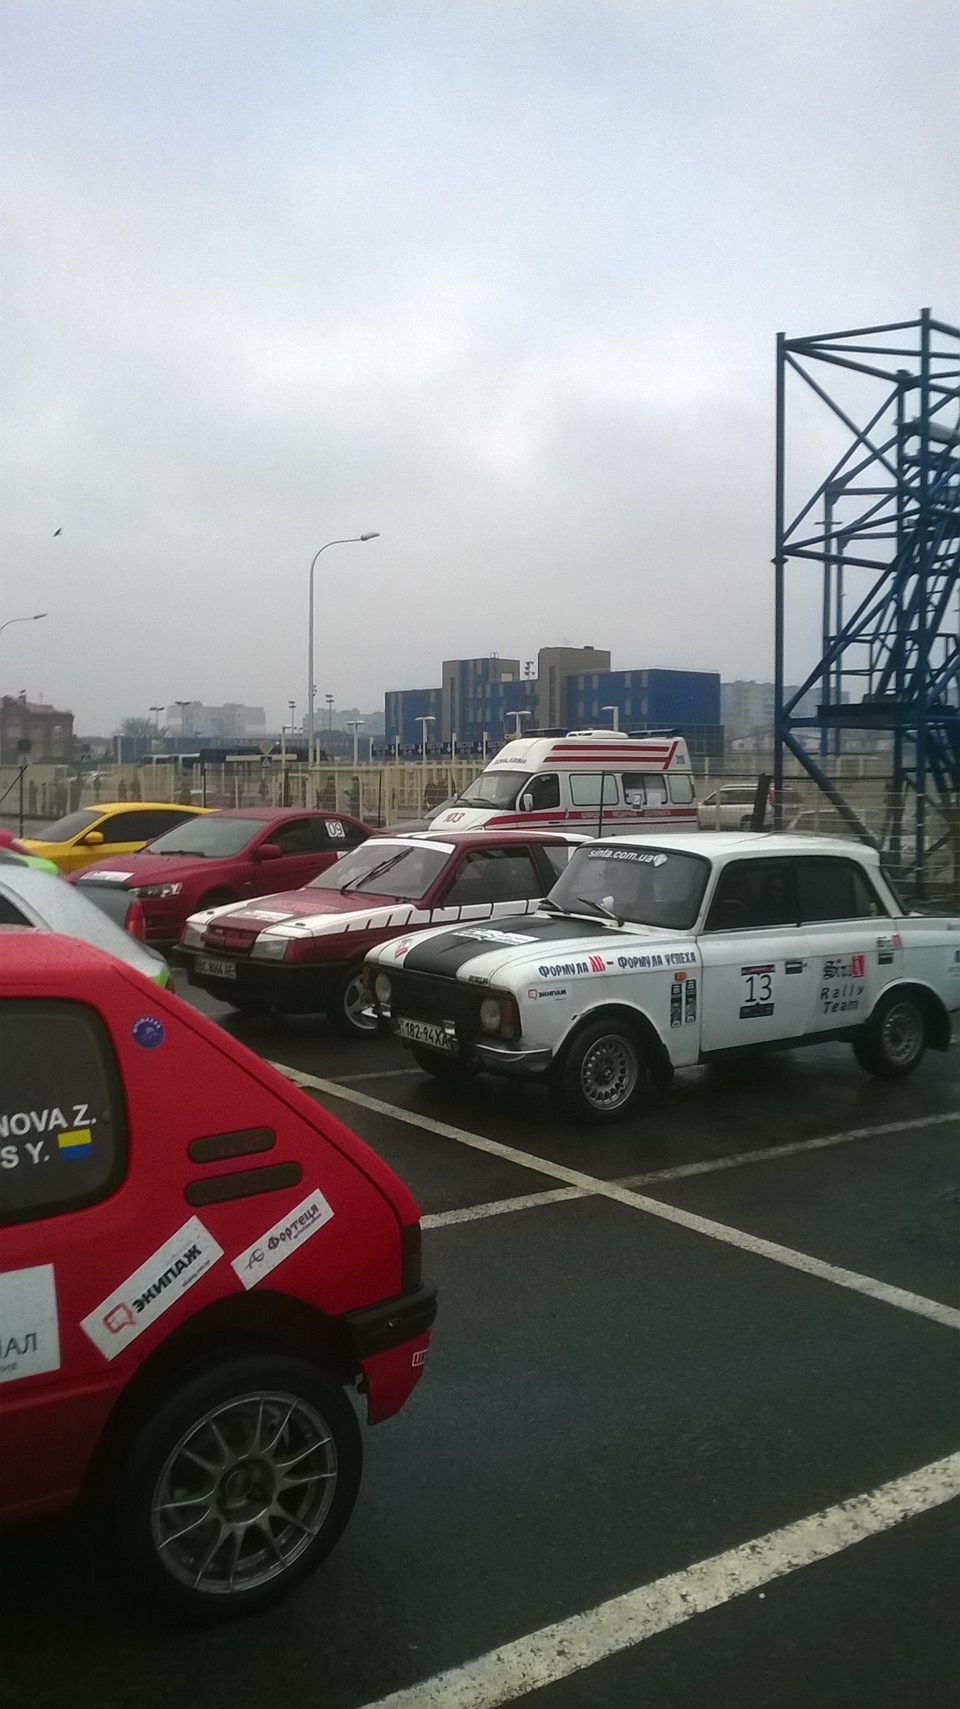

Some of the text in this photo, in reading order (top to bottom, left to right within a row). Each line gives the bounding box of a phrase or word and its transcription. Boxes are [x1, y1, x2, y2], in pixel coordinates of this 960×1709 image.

[328, 822, 343, 836] 09
[443, 812, 466, 823] 103
[588, 848, 654, 863] sinta.com.ua
[538, 961, 589, 977] ФОРМУЛА
[617, 955, 663, 969] ФОРМУЛА
[664, 952, 697, 966] УСПЕХА
[538, 989, 567, 998] ЭКИПАЖ
[745, 974, 772, 1003] 13
[820, 984, 865, 1000] Rally
[823, 1000, 859, 1014] Team
[72, 1103, 97, 1127] Z.
[24, 1140, 50, 1165] Y.
[267, 1204, 320, 1250] Фортеця
[131, 1243, 202, 1314] ЭКИПАЖ
[0, 1332, 38, 1360] АЛ
